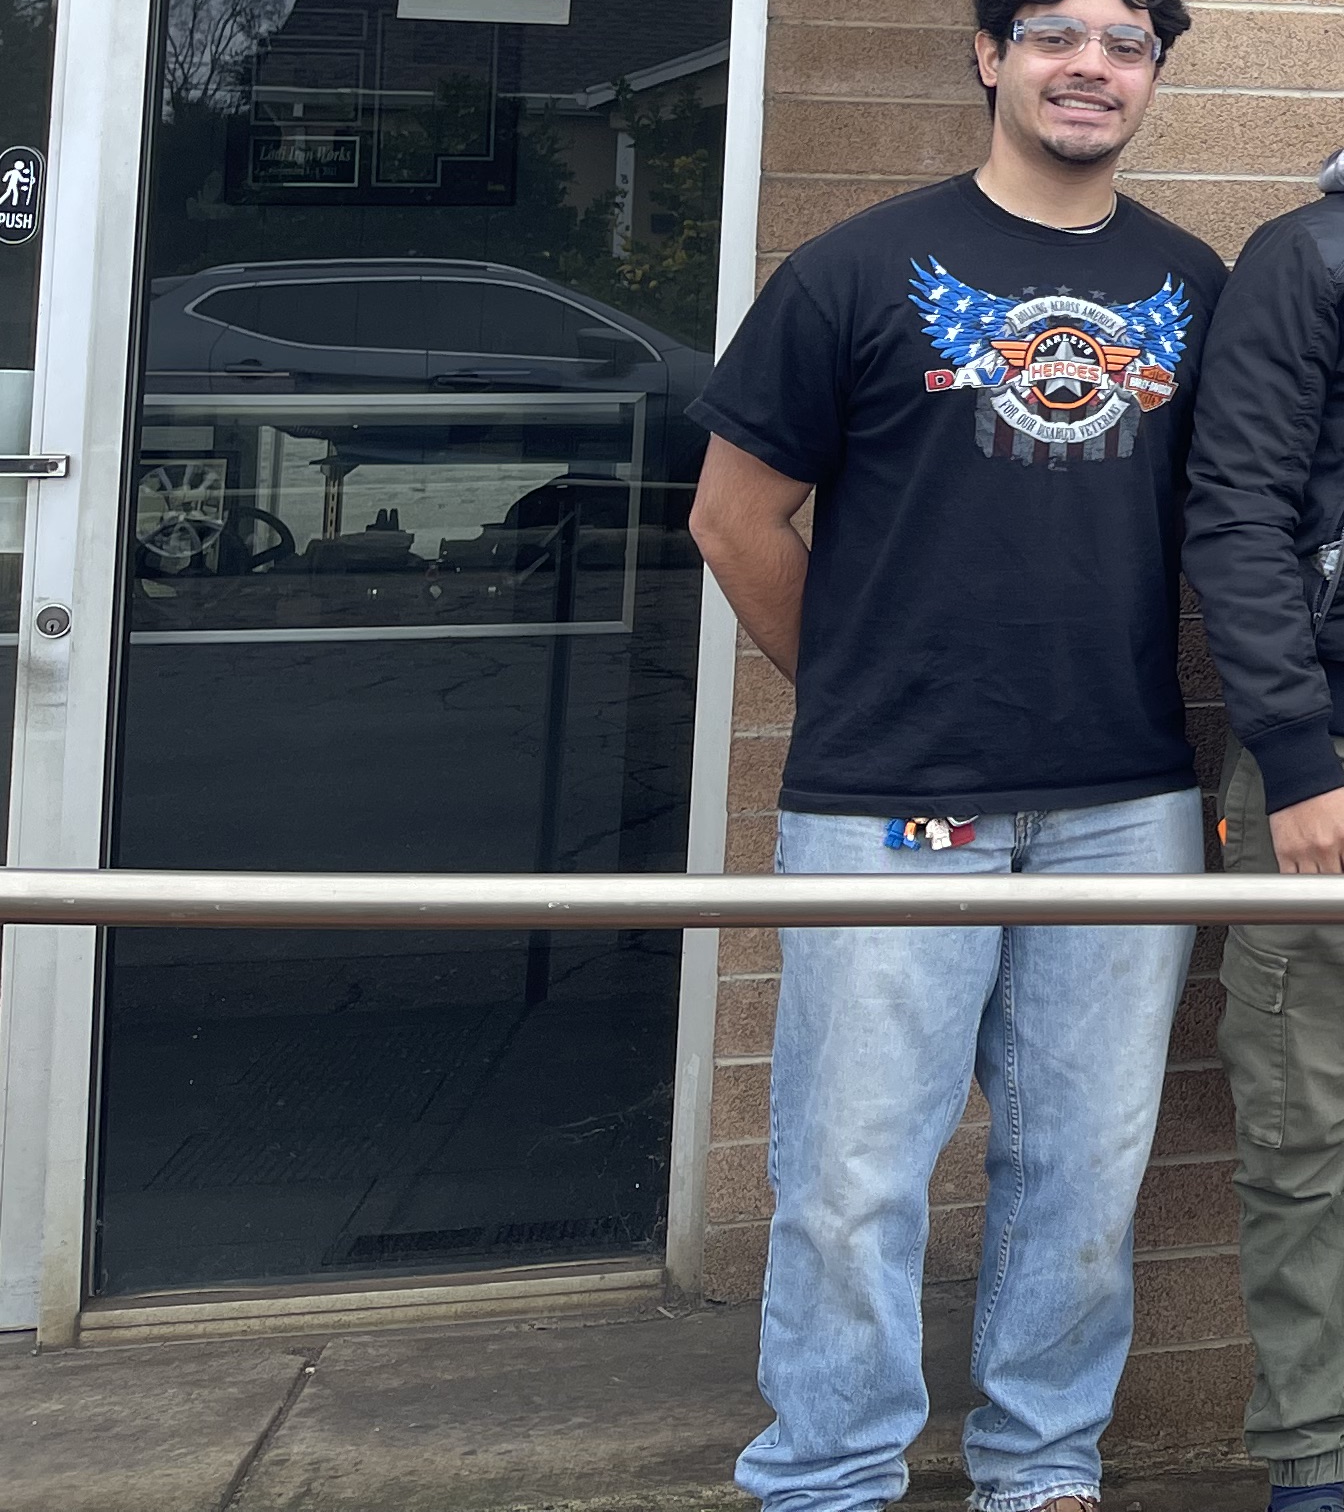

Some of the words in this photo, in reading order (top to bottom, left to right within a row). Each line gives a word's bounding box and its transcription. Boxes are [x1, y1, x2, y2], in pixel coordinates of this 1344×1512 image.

[317, 146, 351, 163] Works
[1050, 300, 1081, 313] ACROSS
[1081, 306, 1117, 329] AMERICA
[926, 367, 1006, 392] DAV
[1032, 361, 1100, 381] HEROES
[998, 399, 1019, 419] FOR
[1016, 413, 1038, 431] OUR
[1079, 403, 1121, 438] VETERANS
